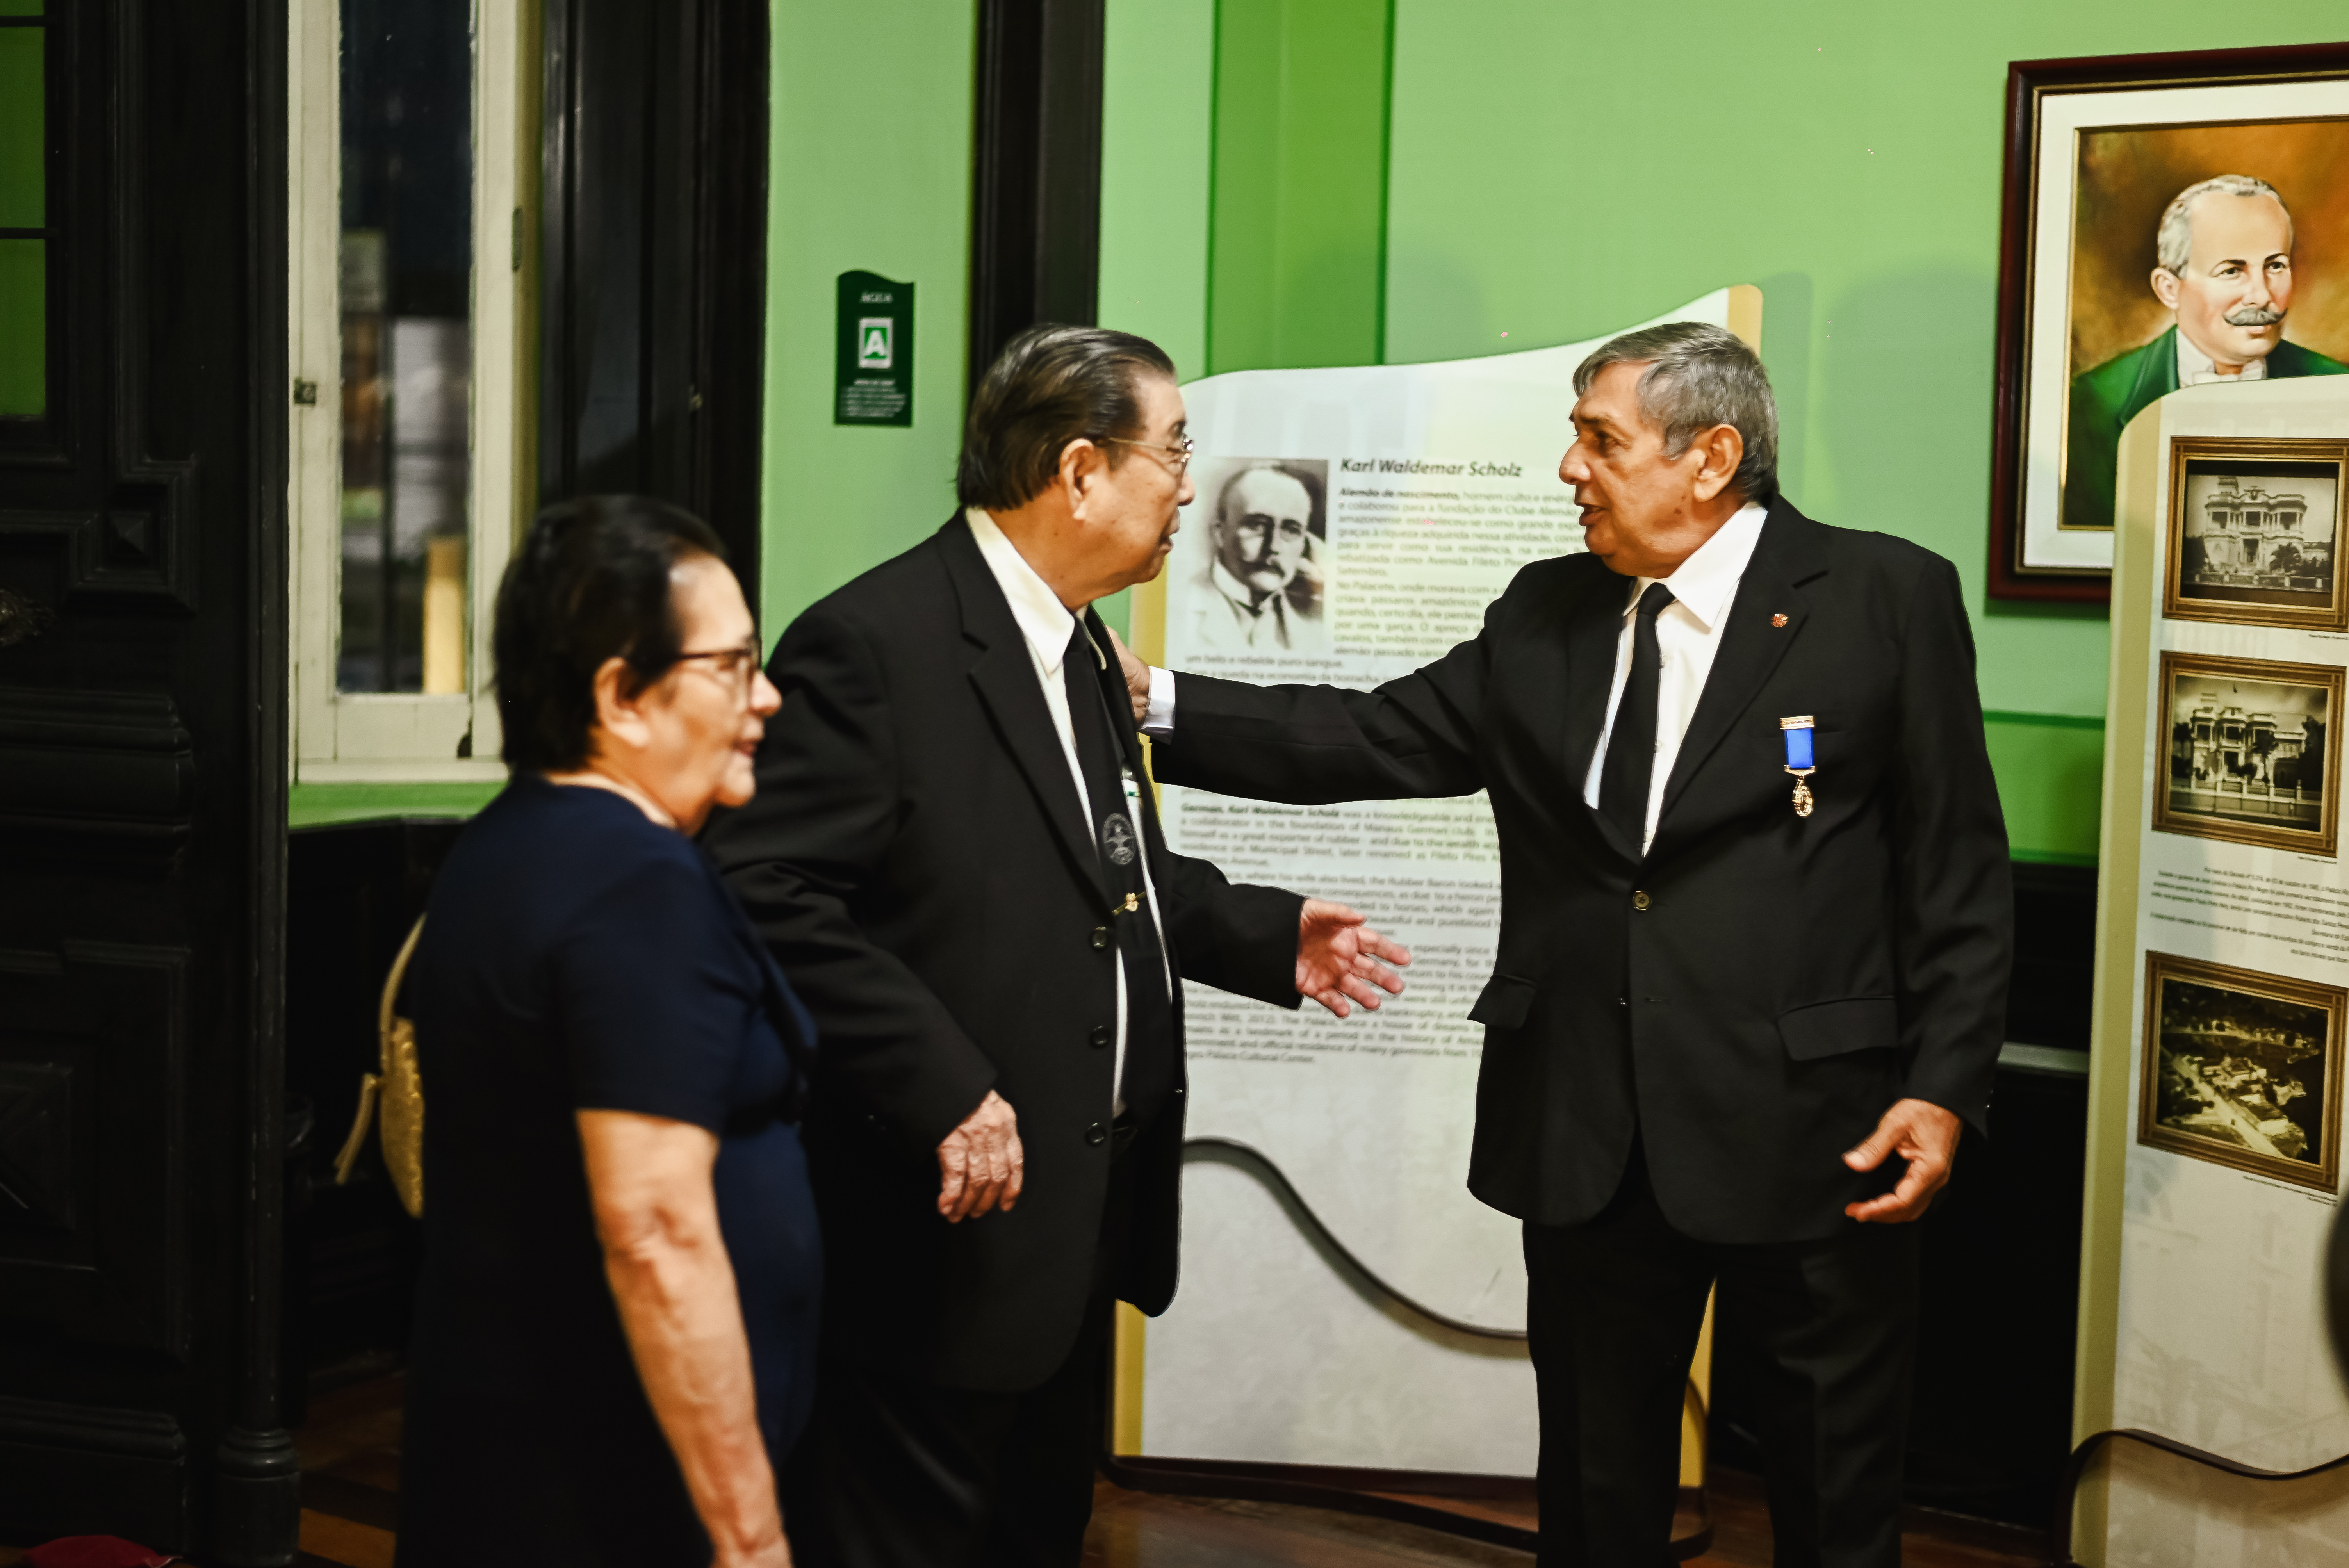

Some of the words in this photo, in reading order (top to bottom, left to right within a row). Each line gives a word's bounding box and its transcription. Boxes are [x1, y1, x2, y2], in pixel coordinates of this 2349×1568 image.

[864, 329, 887, 356] A
[1340, 458, 1375, 473] Karl
[1379, 459, 1464, 475] Waldemar
[1469, 461, 1522, 476] Scholz
